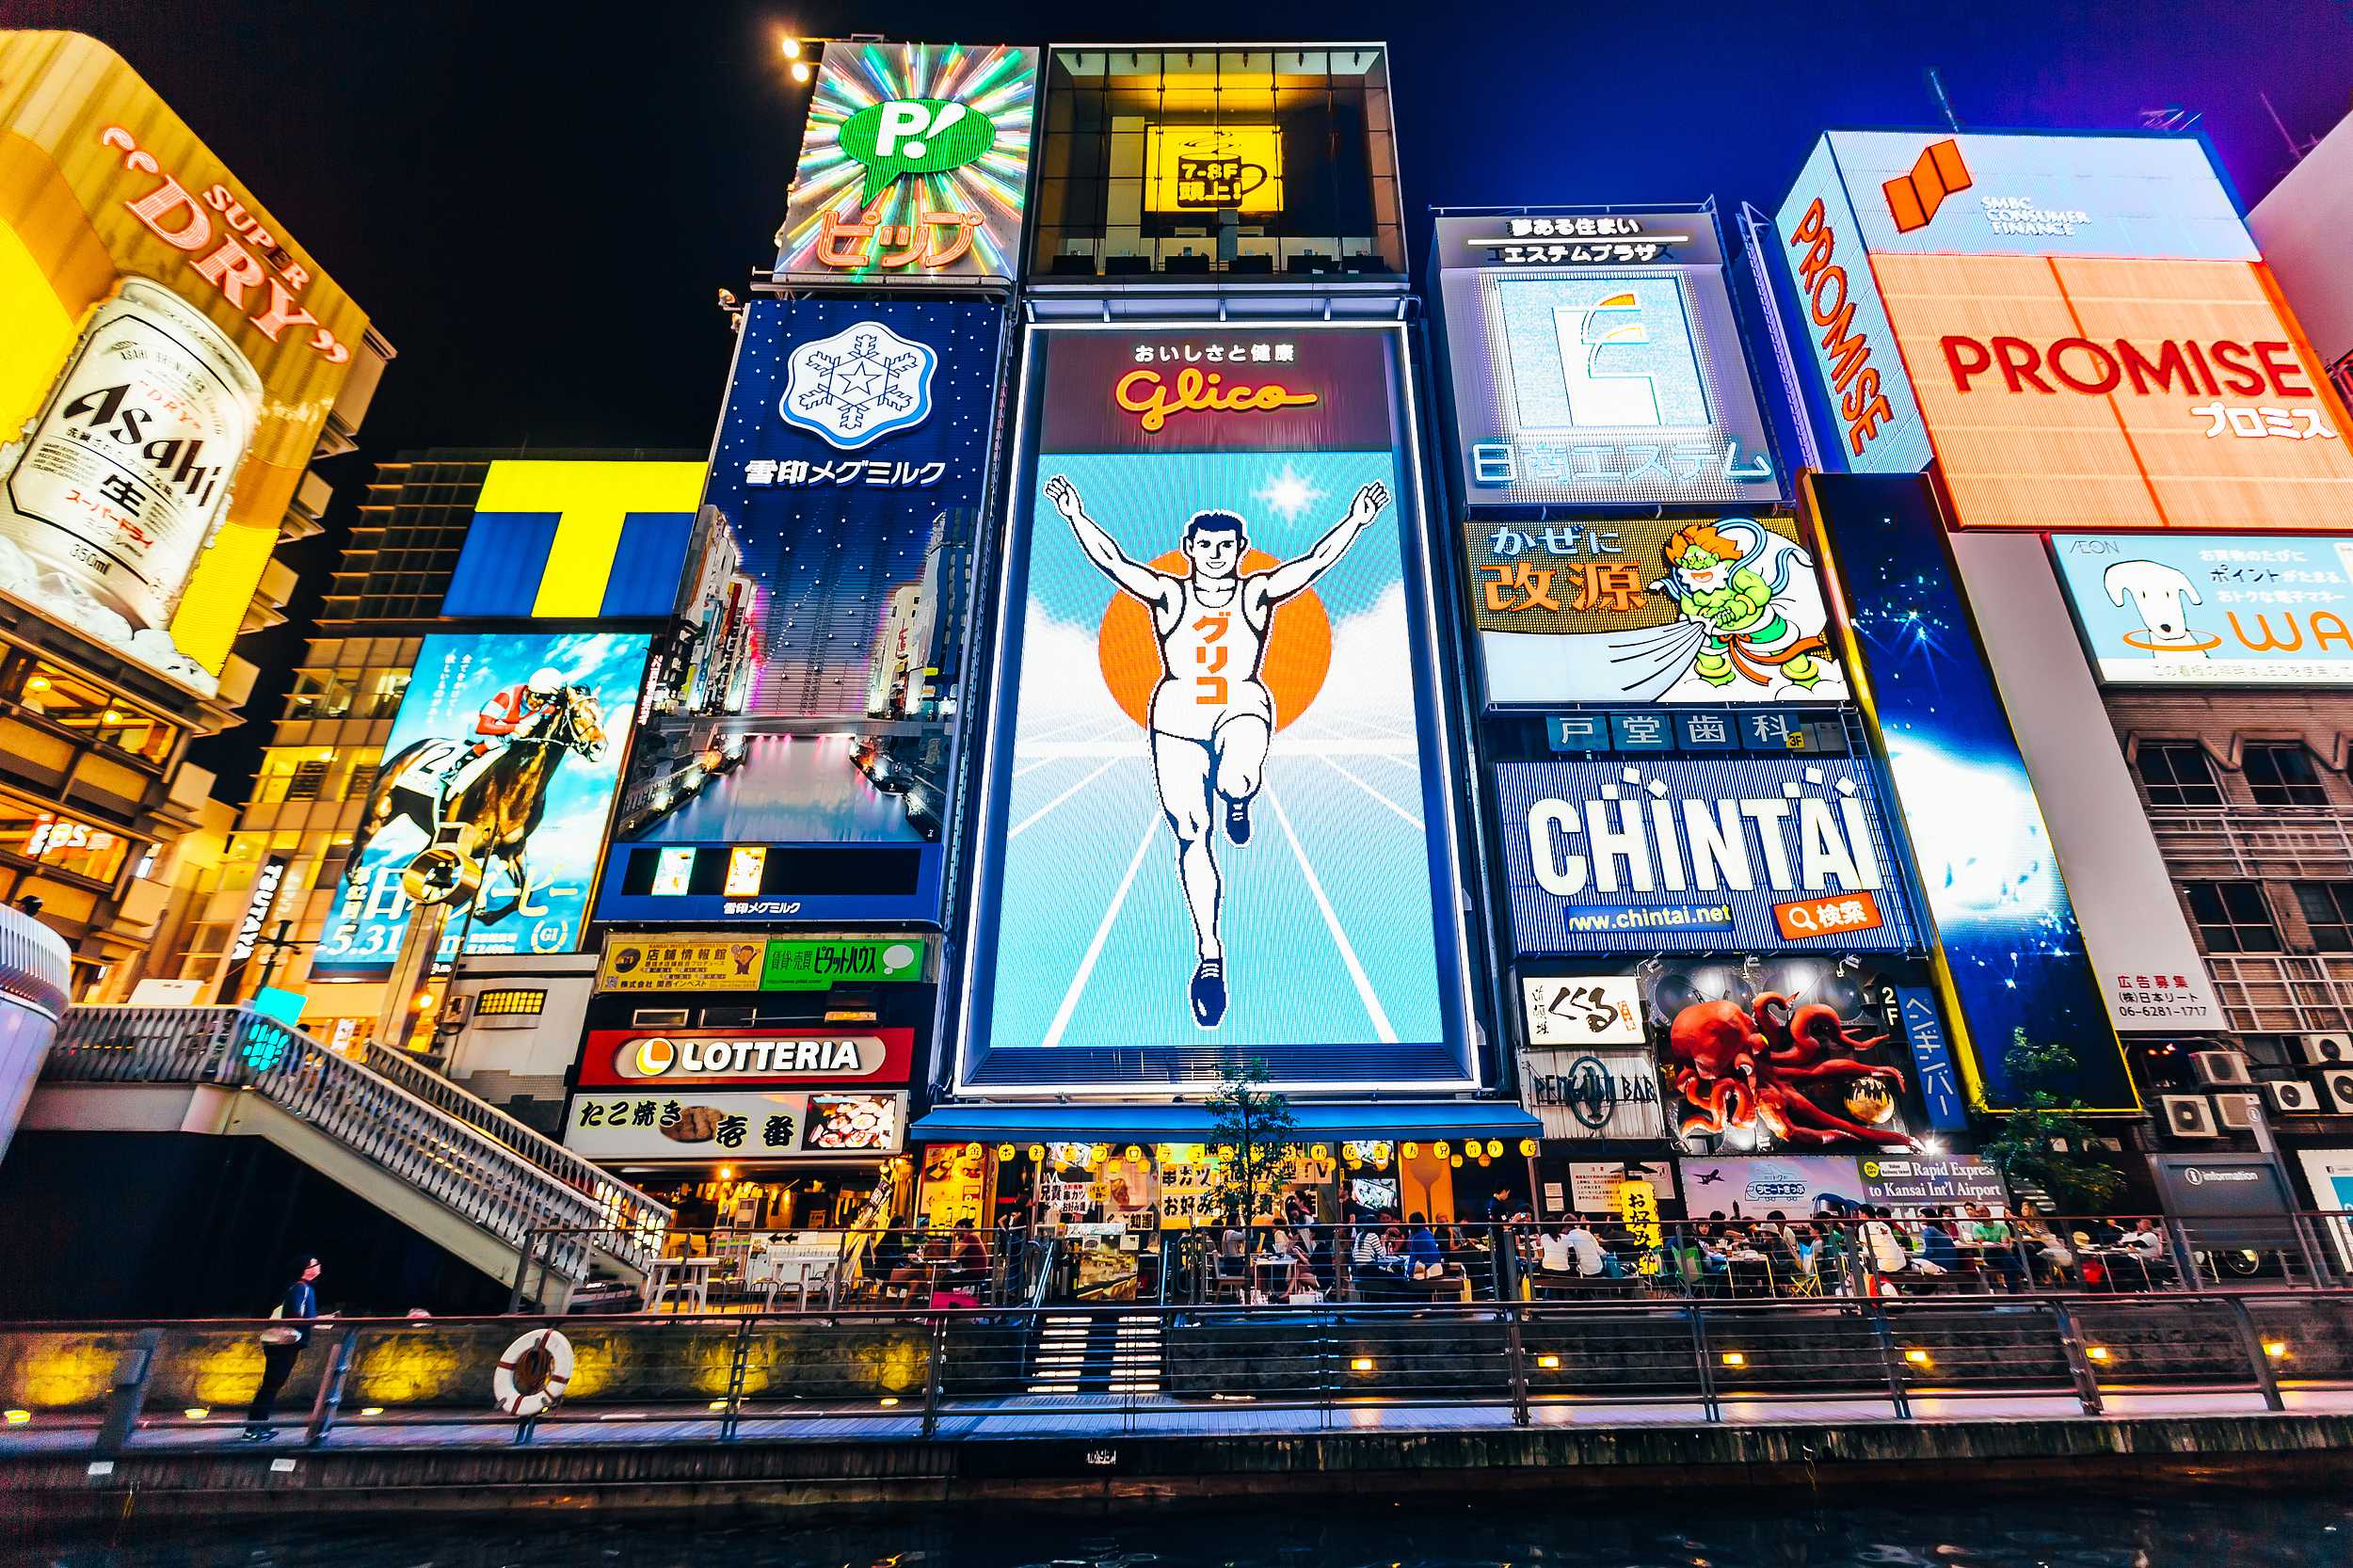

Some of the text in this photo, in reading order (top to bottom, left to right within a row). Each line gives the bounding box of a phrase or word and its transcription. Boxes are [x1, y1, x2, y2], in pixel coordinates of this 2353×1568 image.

[1180, 160, 1239, 182] 7-8F
[1981, 196, 2033, 209] SMBC
[1986, 210, 2091, 224] CONSUMER
[202, 183, 312, 289] SUPER
[815, 209, 985, 268] ピップ
[1510, 217, 1640, 236] 夢ある住まい
[1991, 222, 2075, 236] FINANCE
[1504, 243, 1657, 263] エステムプラザ
[1791, 197, 1893, 457] PROMISE
[1134, 343, 1295, 363] おいしさと健康
[1940, 335, 2315, 396] PROMISE
[1114, 368, 1317, 431] Glico
[2190, 402, 2337, 440] プロミス
[62, 384, 222, 507] Asahi
[744, 459, 946, 488] 雪印メグミルク
[1472, 441, 1772, 483] 日商エステム
[100, 474, 147, 518] 生
[65, 488, 155, 549] スーパードライ
[1490, 525, 1623, 557] かぜに
[70, 543, 112, 576] 350ml
[1479, 562, 1647, 613] 改源
[1193, 611, 1230, 705] グリコ
[1558, 715, 1802, 747] 戸堂歯科 3F
[1528, 767, 1883, 897] CHINTAI
[231, 865, 284, 960] TSUTAYA
[723, 901, 801, 915] 雪印メグミルク
[1568, 904, 1732, 933] ww.chintai.net
[1817, 900, 1868, 929] 検索
[646, 948, 728, 961] 店舗情報館
[813, 945, 876, 975] ピタットハウス
[2118, 974, 2189, 989] 広告募集
[1548, 986, 1619, 1033] くくる
[1881, 986, 1898, 1026] 2F
[2119, 991, 2199, 1004] (株)日本リート
[2119, 1006, 2207, 1017] 06-6281-1717
[680, 1040, 860, 1073] LOTTERIA
[1621, 1074, 1658, 1104] BAR
[580, 1099, 683, 1128] たこ焼き
[1912, 1162, 1996, 1180] Rapid Express
[2201, 1172, 2259, 1181] information
[1040, 1184, 1062, 1201] 兄貴
[1869, 1186, 1881, 1197] to
[1885, 1183, 1926, 1197] Kansai
[1957, 1182, 2003, 1202] Airport
